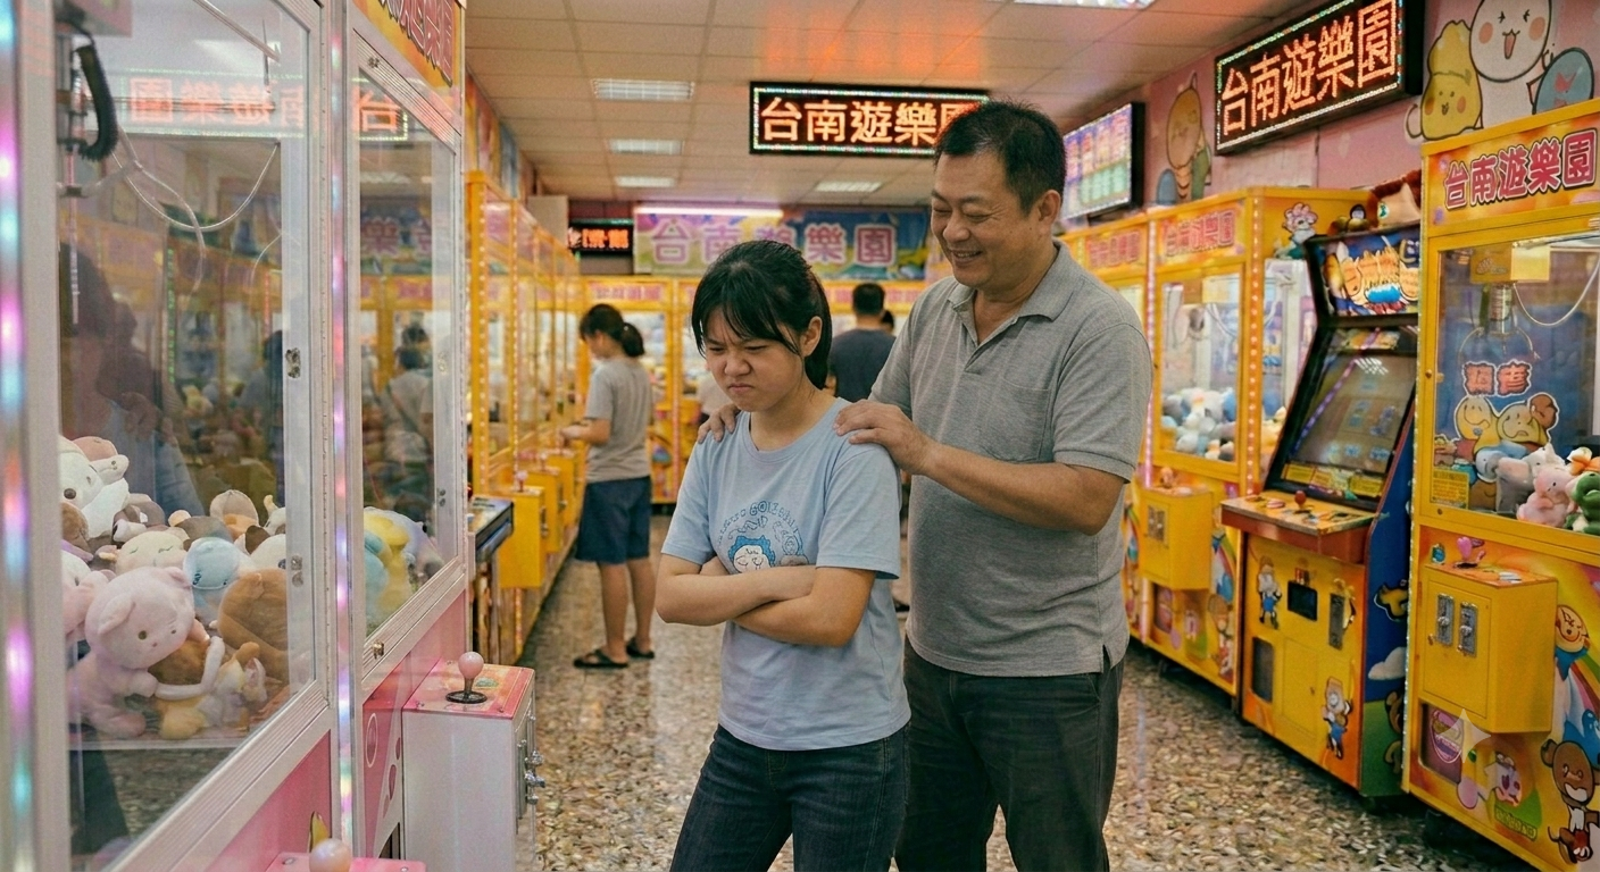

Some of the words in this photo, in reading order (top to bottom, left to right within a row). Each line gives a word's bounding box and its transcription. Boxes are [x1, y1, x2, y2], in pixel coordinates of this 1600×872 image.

[1222, 0, 1396, 135] 台南遊樂園
[761, 97, 980, 146] 台南遊樂
